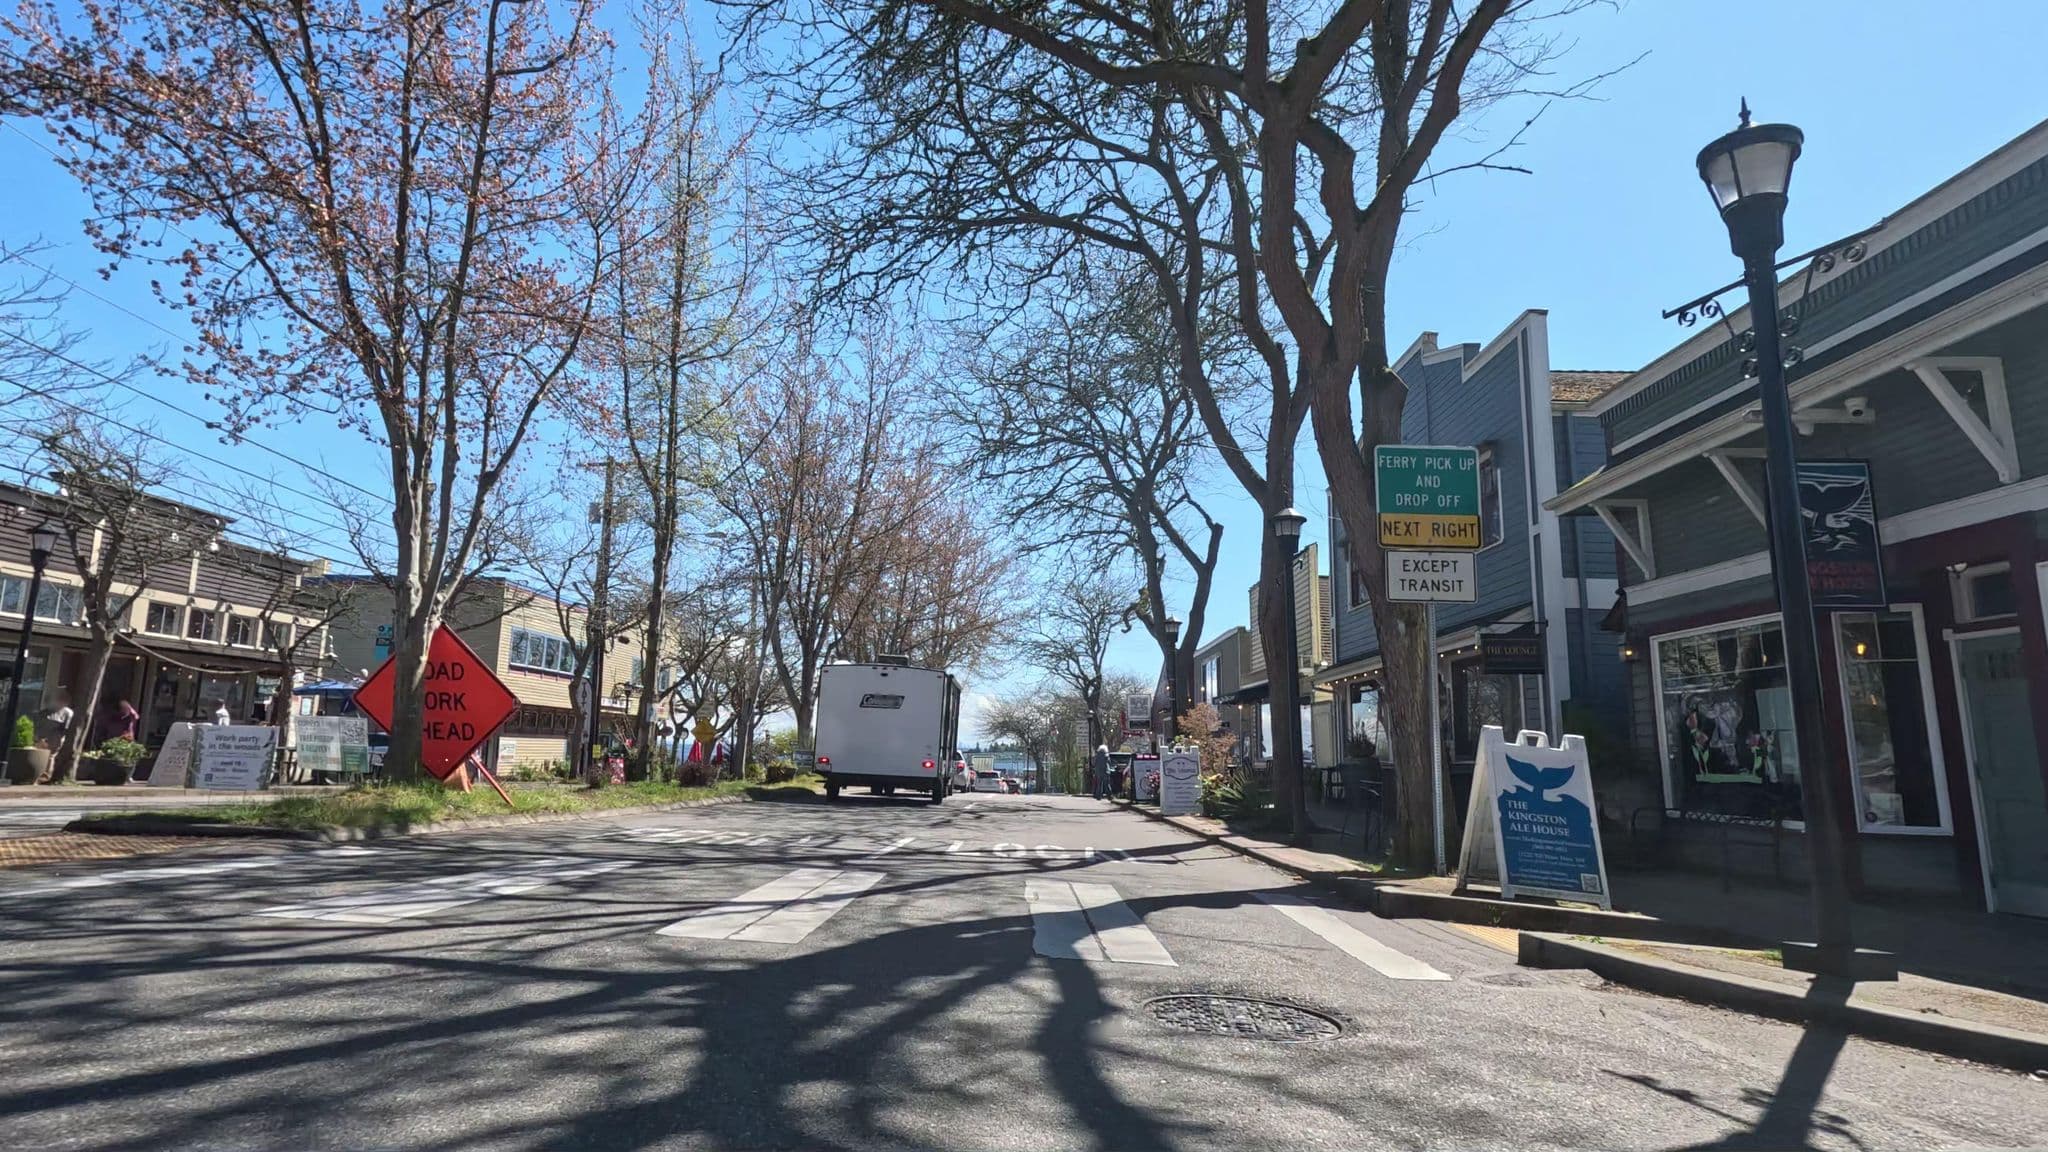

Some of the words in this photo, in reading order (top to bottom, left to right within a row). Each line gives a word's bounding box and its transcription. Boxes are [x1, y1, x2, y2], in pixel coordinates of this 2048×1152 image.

[1378, 455, 1417, 469] FERRY
[1425, 456, 1452, 470] PICK
[1459, 458, 1475, 471] UP
[1415, 475, 1441, 489] AND
[1395, 493, 1429, 507] DROP
[1437, 495, 1461, 508] OFF
[1383, 521, 1420, 537] NEXT
[1431, 522, 1476, 539] RIGHT
[1402, 559, 1459, 574] EXCEPT
[1399, 579, 1464, 593] TRANSIT
[423, 662, 465, 681] OAD
[424, 692, 467, 711] ORK
[423, 722, 475, 741] HEAD
[1505, 799, 1528, 810] THE
[1508, 810, 1567, 825] KINGSTON
[1510, 822, 1531, 833] ALE
[1532, 824, 1570, 837] HOUSE
